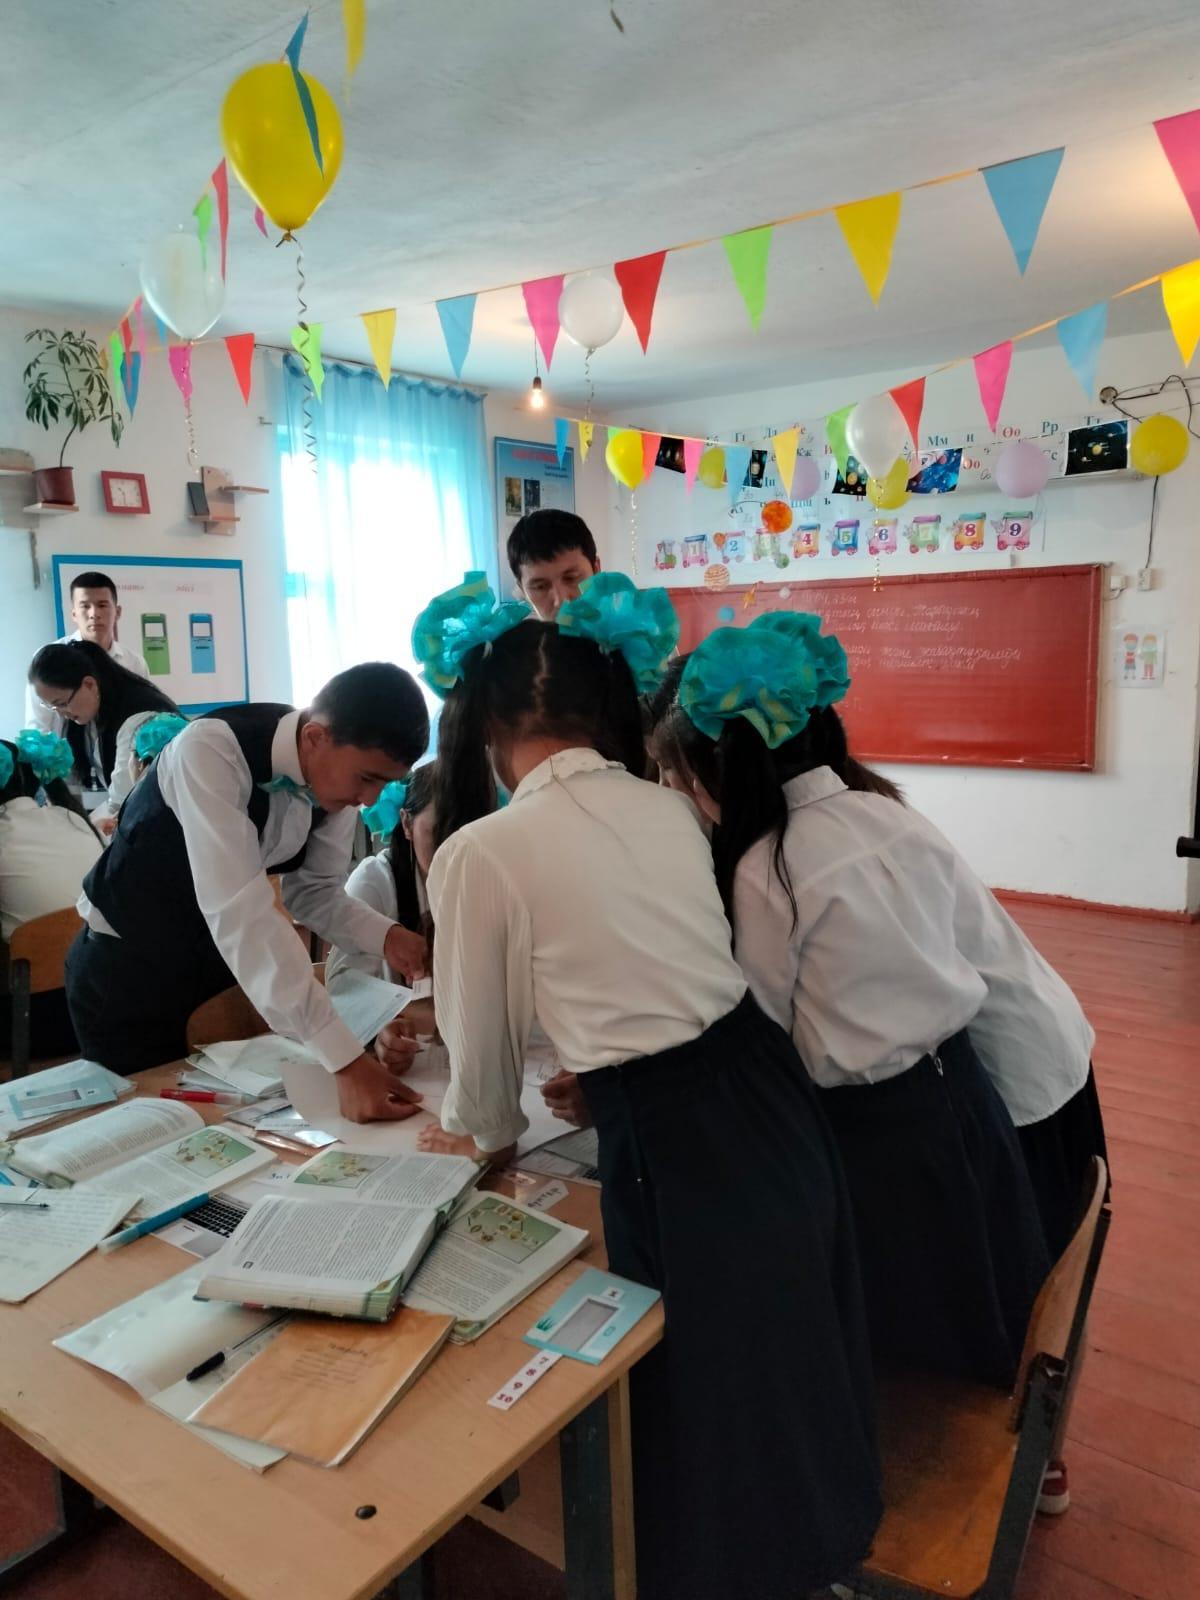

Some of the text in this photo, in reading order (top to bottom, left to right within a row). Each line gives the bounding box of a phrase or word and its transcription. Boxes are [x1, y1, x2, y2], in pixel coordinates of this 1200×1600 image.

[928, 435, 948, 447] Мм
[1042, 421, 1058, 434] Рр
[730, 540, 739, 552] 2
[802, 533, 813, 546] 4
[842, 531, 852, 543] 5
[878, 528, 889, 541] 6
[964, 523, 976, 537] 8
[1009, 522, 1022, 537] 9
